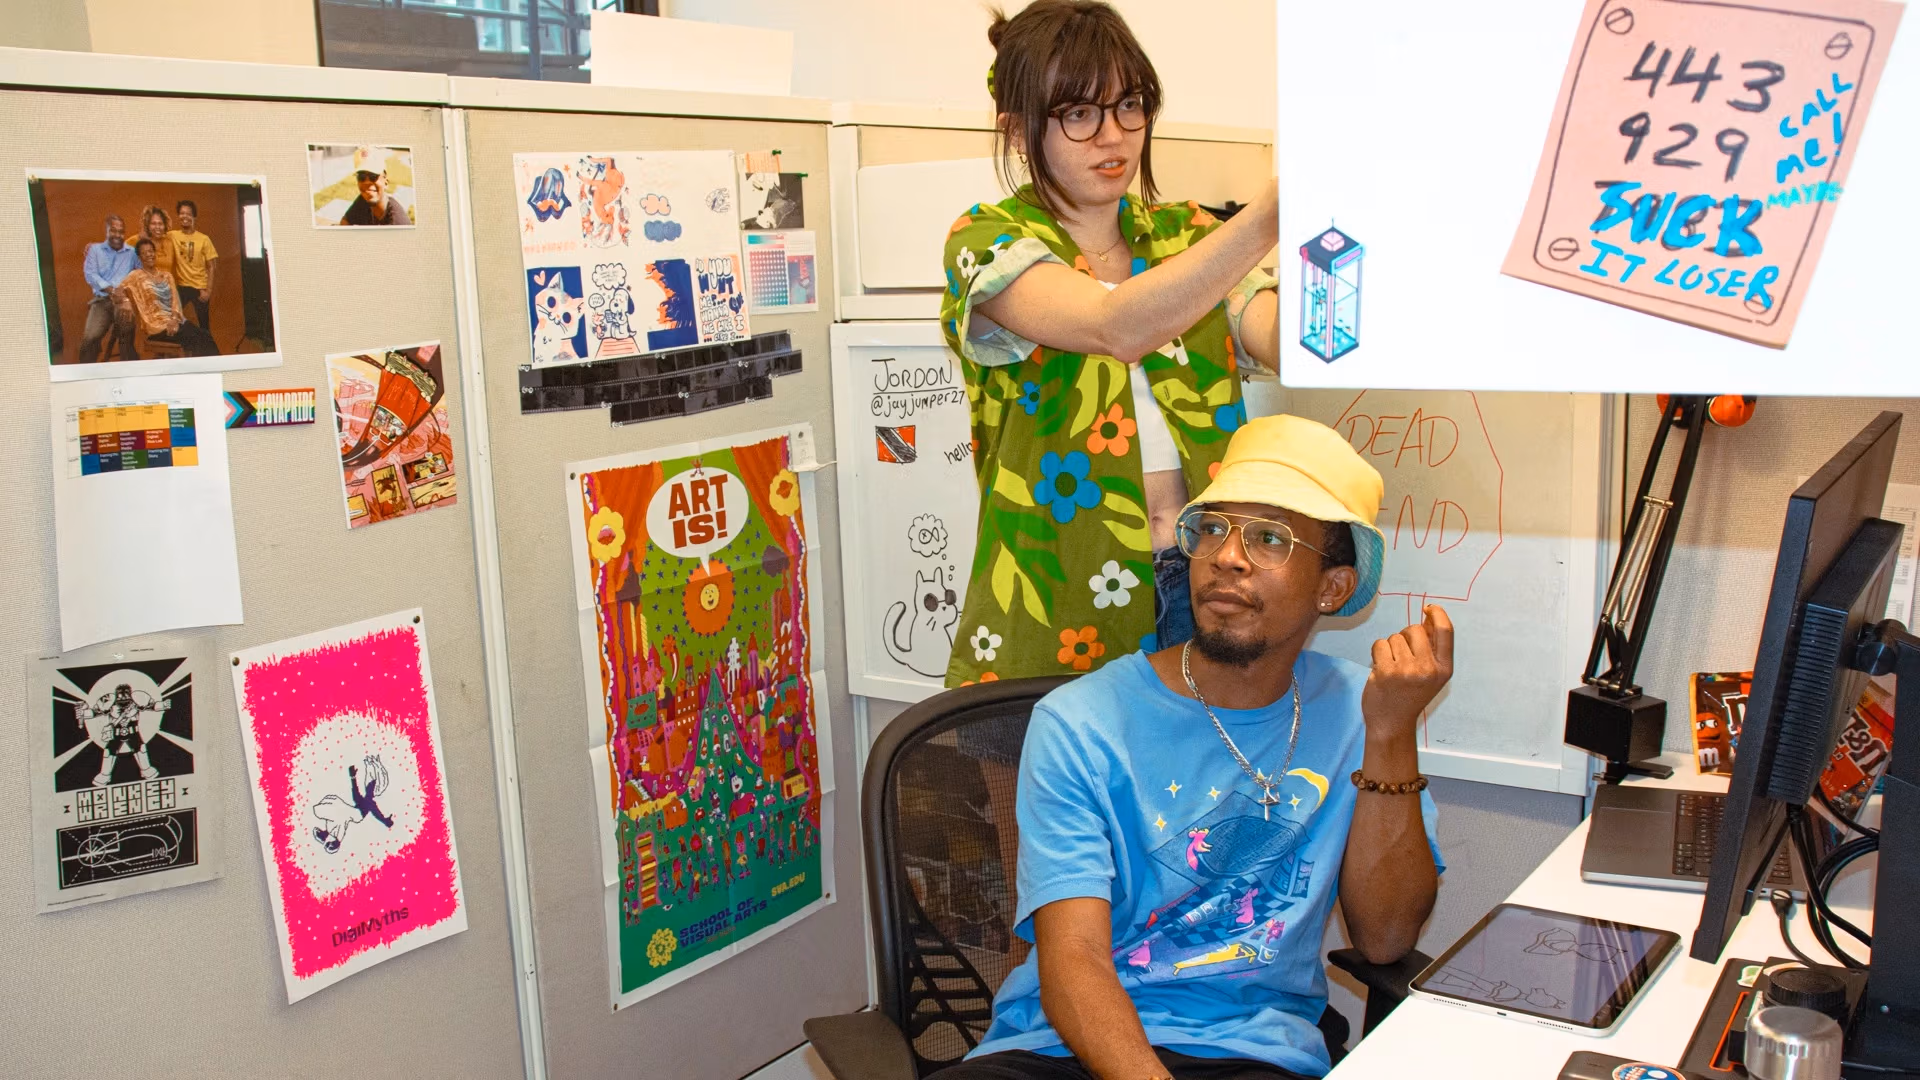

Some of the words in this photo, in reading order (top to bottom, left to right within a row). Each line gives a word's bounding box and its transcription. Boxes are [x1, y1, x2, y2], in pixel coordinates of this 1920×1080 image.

[1624, 40, 1785, 113] 443
[1779, 72, 1853, 138] CALL
[1619, 111, 1749, 182] 929
[1589, 180, 1763, 257] SUCK
[1580, 239, 1646, 283] IT
[1654, 258, 1779, 310] LOSER
[871, 357, 953, 393] JORDON
[871, 389, 966, 420] @jayjumper27
[1347, 407, 1459, 468] DEAD
[668, 473, 729, 520] ART
[1378, 494, 1469, 554] ND
[672, 509, 729, 550] IS!
[331, 906, 409, 948] DigiMyths
[680, 906, 733, 939] SCHOOL
[736, 896, 754, 912] OF
[680, 919, 733, 949] VISUAL
[734, 899, 768, 924] ARTS
